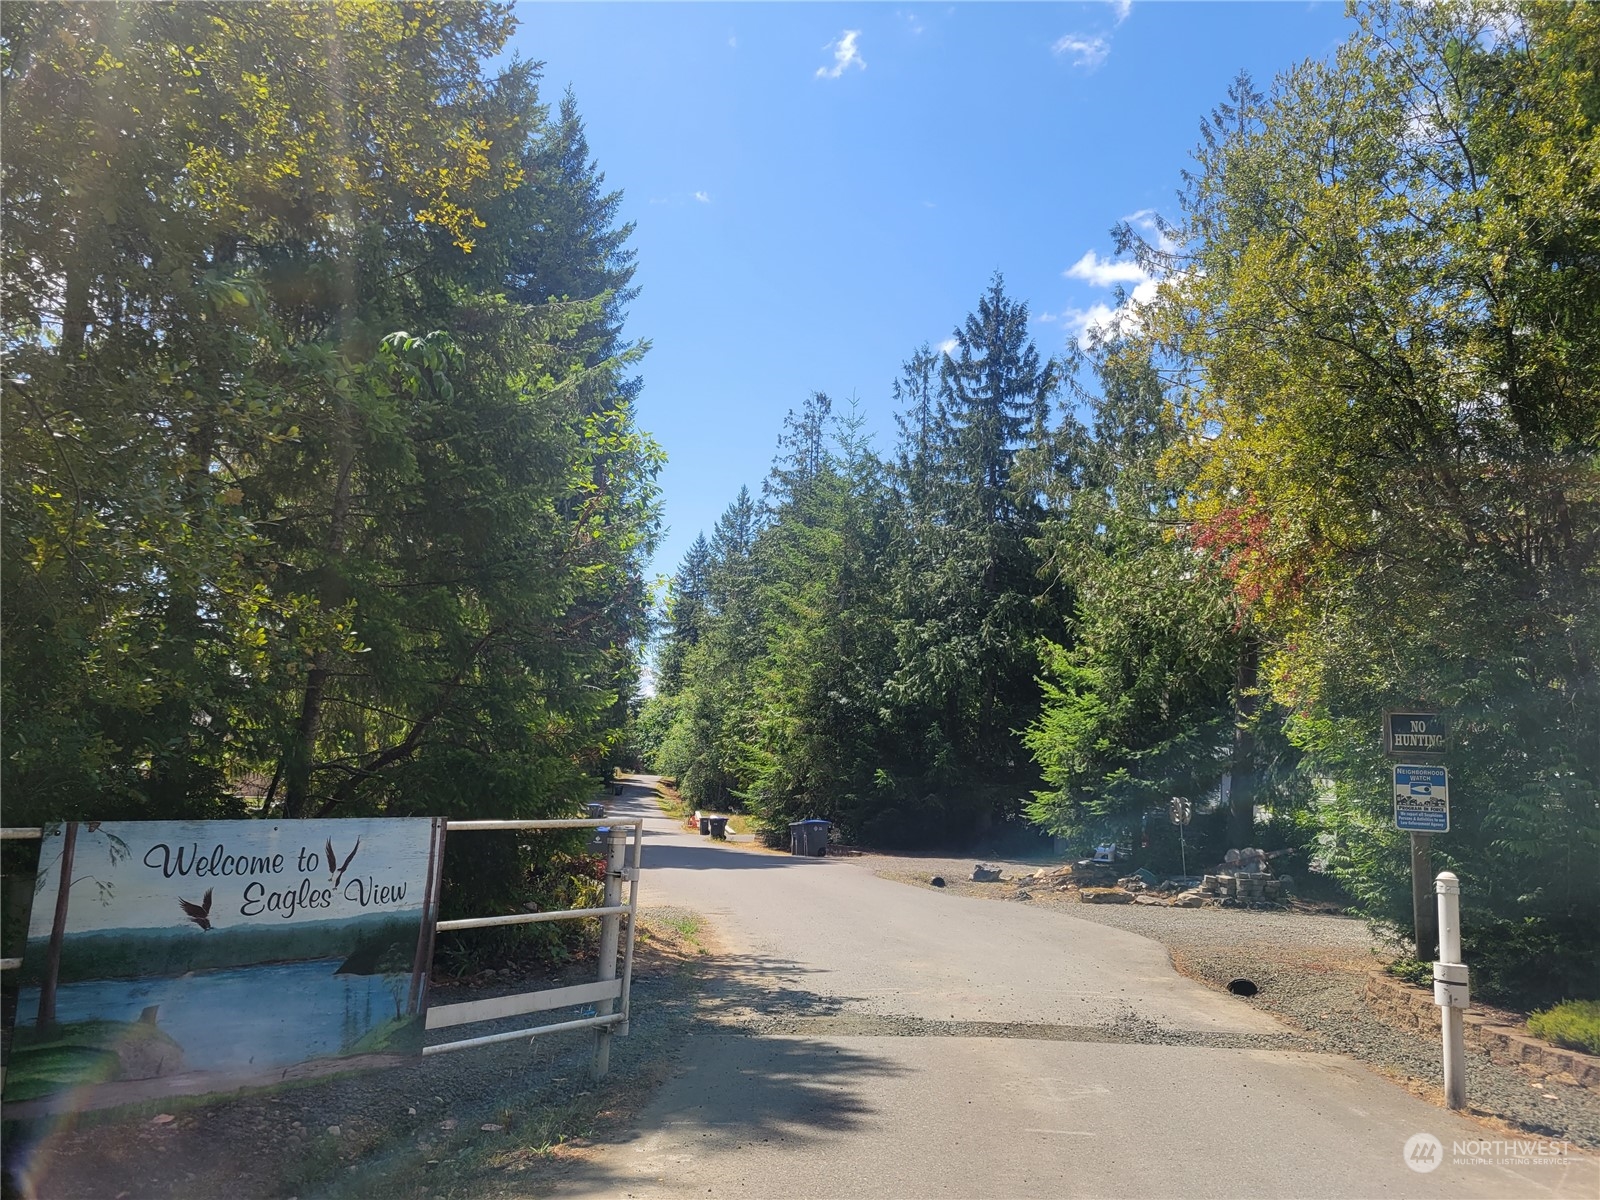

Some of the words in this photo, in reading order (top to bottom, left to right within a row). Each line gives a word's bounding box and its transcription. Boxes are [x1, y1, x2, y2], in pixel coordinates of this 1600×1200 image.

[1410, 720, 1426, 732] NO
[1394, 734, 1442, 746] HUNTING
[144, 843, 284, 878] Welcome
[298, 847, 319, 873] to
[240, 878, 332, 919] Eagles
[344, 876, 406, 907] View
